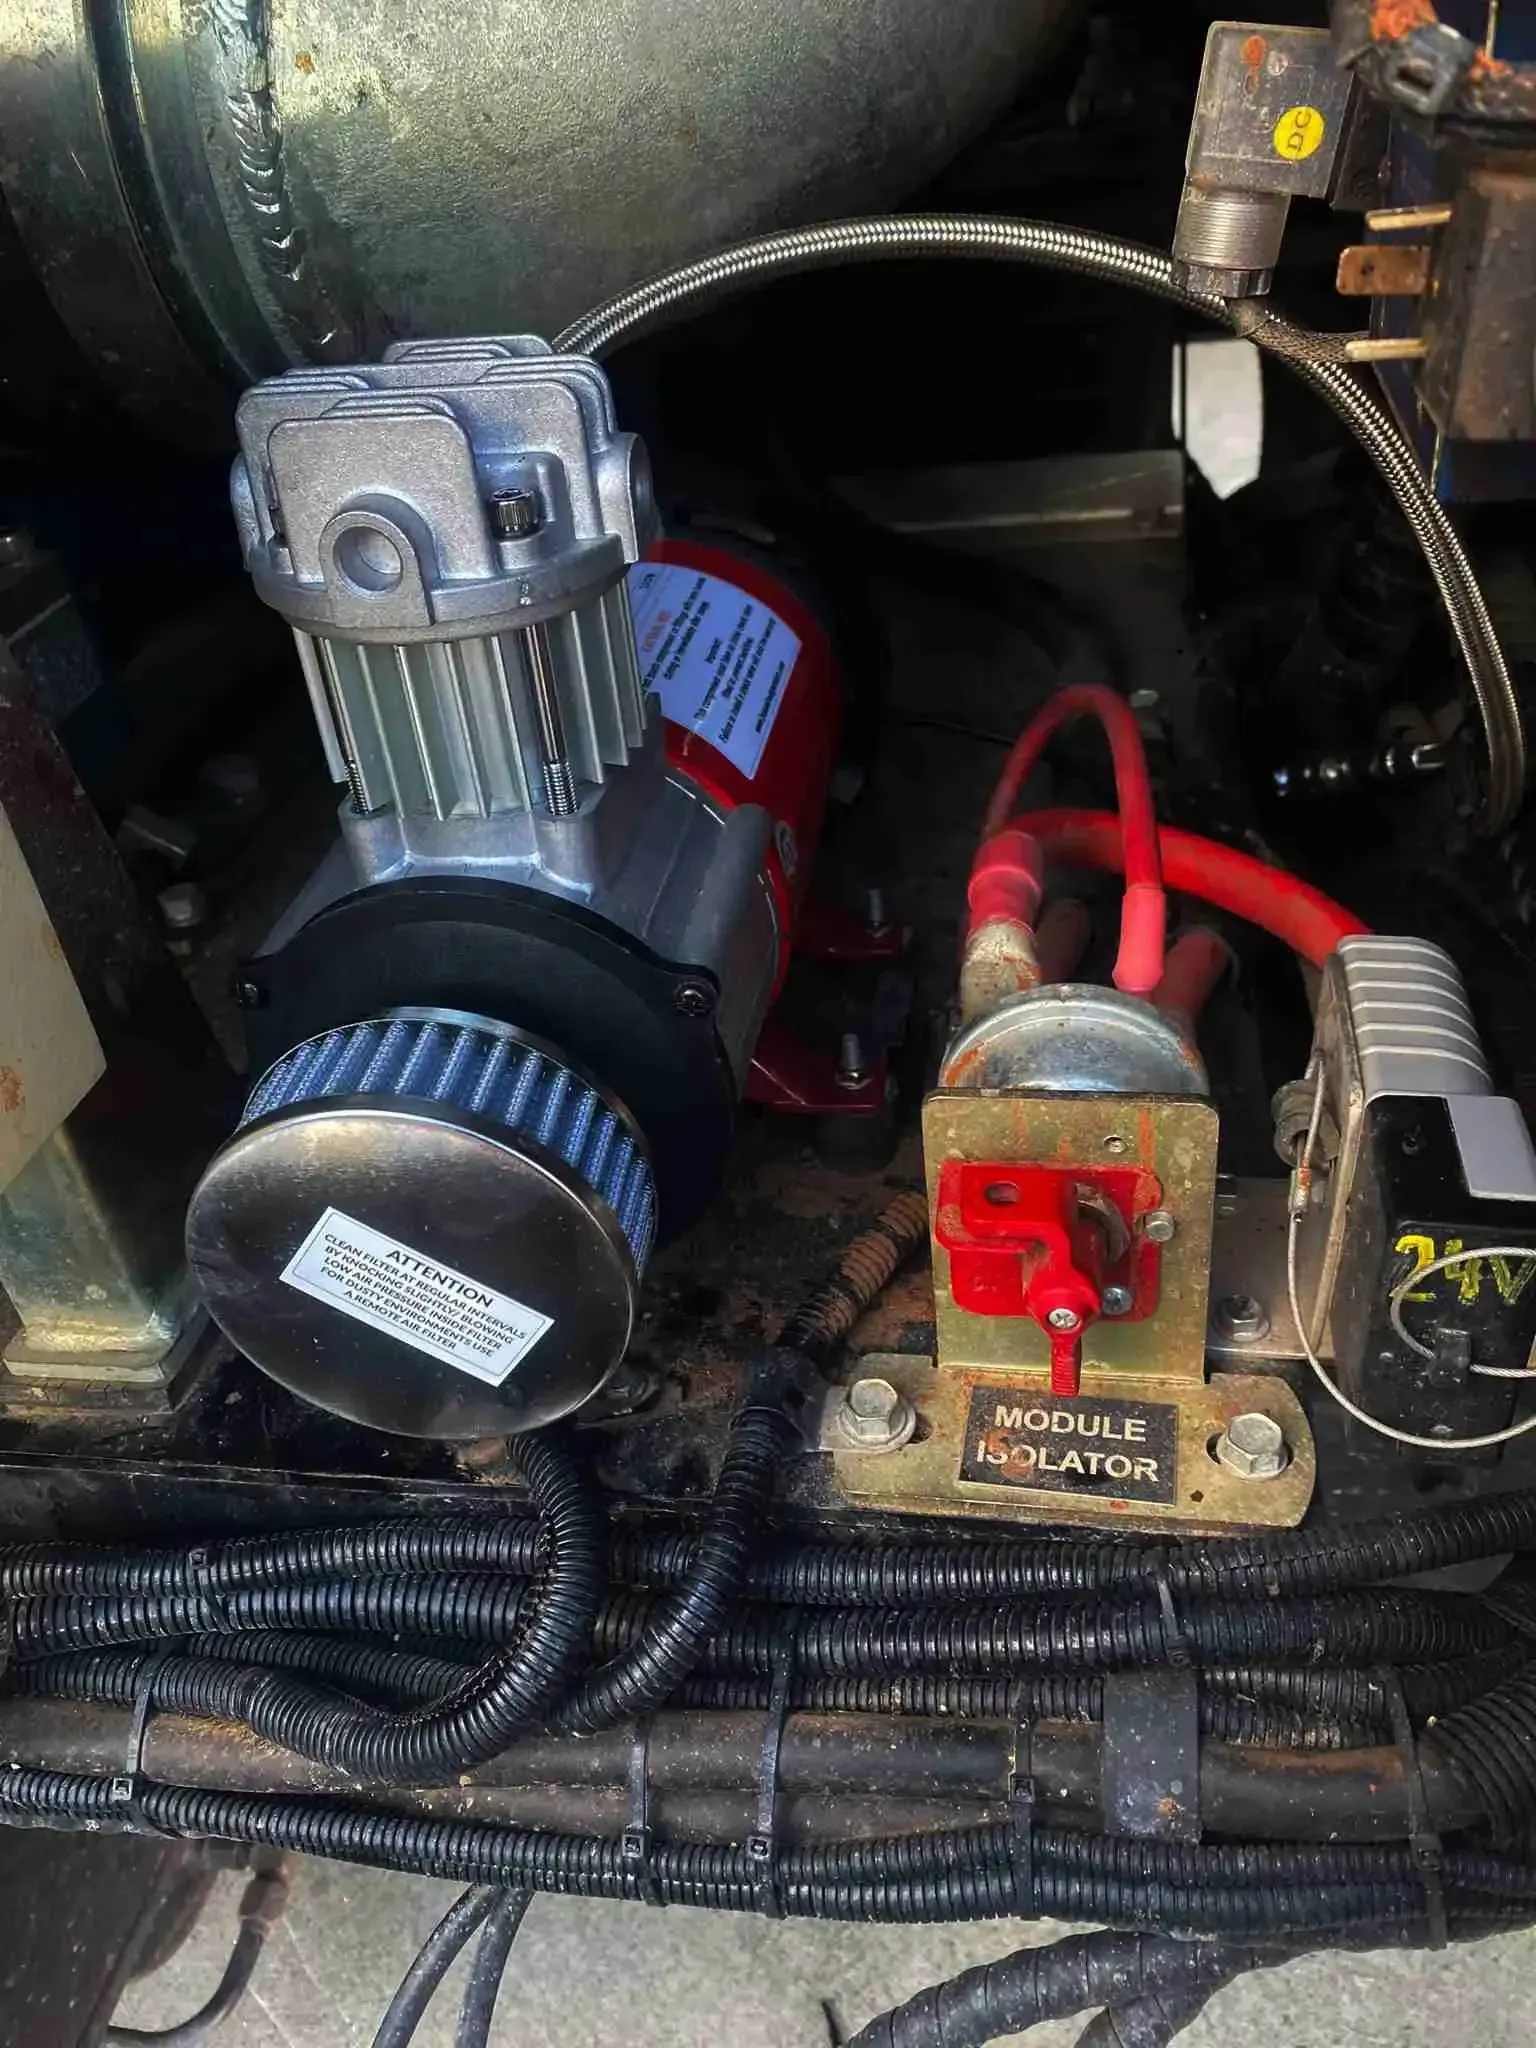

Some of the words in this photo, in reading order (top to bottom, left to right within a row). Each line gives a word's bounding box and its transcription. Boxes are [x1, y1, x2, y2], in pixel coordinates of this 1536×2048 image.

[1287, 110, 1312, 152] DC
[324, 1233, 362, 1256] CLEAN
[362, 1252, 399, 1276] FILTER
[399, 1272, 416, 1283] AT
[415, 1280, 467, 1309] REGULAR
[467, 1306, 527, 1340] INTERVALS
[324, 1245, 342, 1256] BY
[341, 1253, 403, 1289] KNOCKING
[459, 1314, 513, 1344] BLOWING
[324, 1256, 352, 1273] LOW
[351, 1272, 372, 1285] AIR
[373, 1281, 429, 1313] PRESSURE
[429, 1310, 467, 1332] INSIDE
[466, 1328, 501, 1349] FILTER
[385, 1250, 493, 1307] ATTENTION
[1389, 1234, 1536, 1306] 24V
[320, 1266, 344, 1282] FOR
[344, 1278, 384, 1300] DUSTY
[383, 1298, 472, 1345] ENVIRONMENTS
[472, 1341, 494, 1356] USE
[343, 1290, 352, 1298] A
[353, 1294, 402, 1321] REMOTE
[400, 1319, 421, 1331] AIR
[421, 1328, 456, 1349] FILTER
[994, 1405, 1147, 1443] MODULE
[976, 1439, 1160, 1483] ISOLATOR
